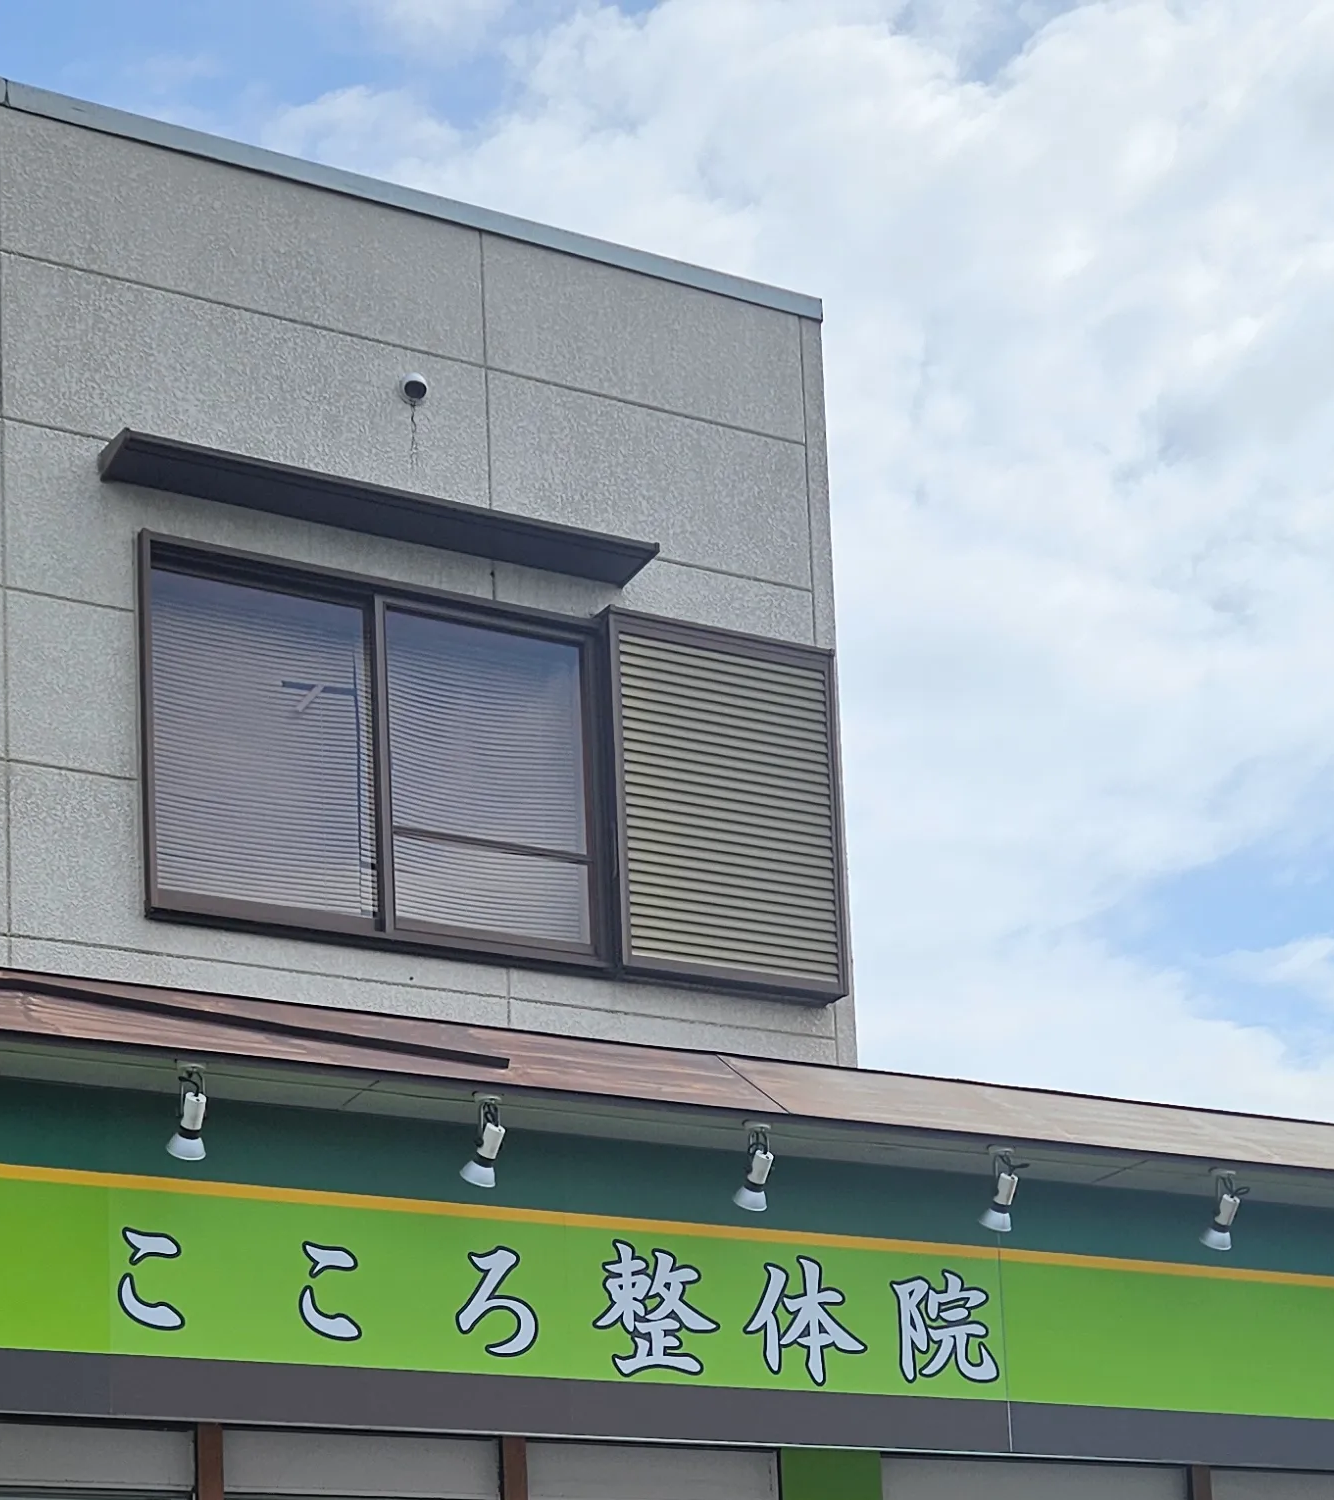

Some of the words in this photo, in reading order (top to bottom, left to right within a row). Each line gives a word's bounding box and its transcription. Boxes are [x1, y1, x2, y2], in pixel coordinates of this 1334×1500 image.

[118, 1227, 1000, 1386] こころ整体院
